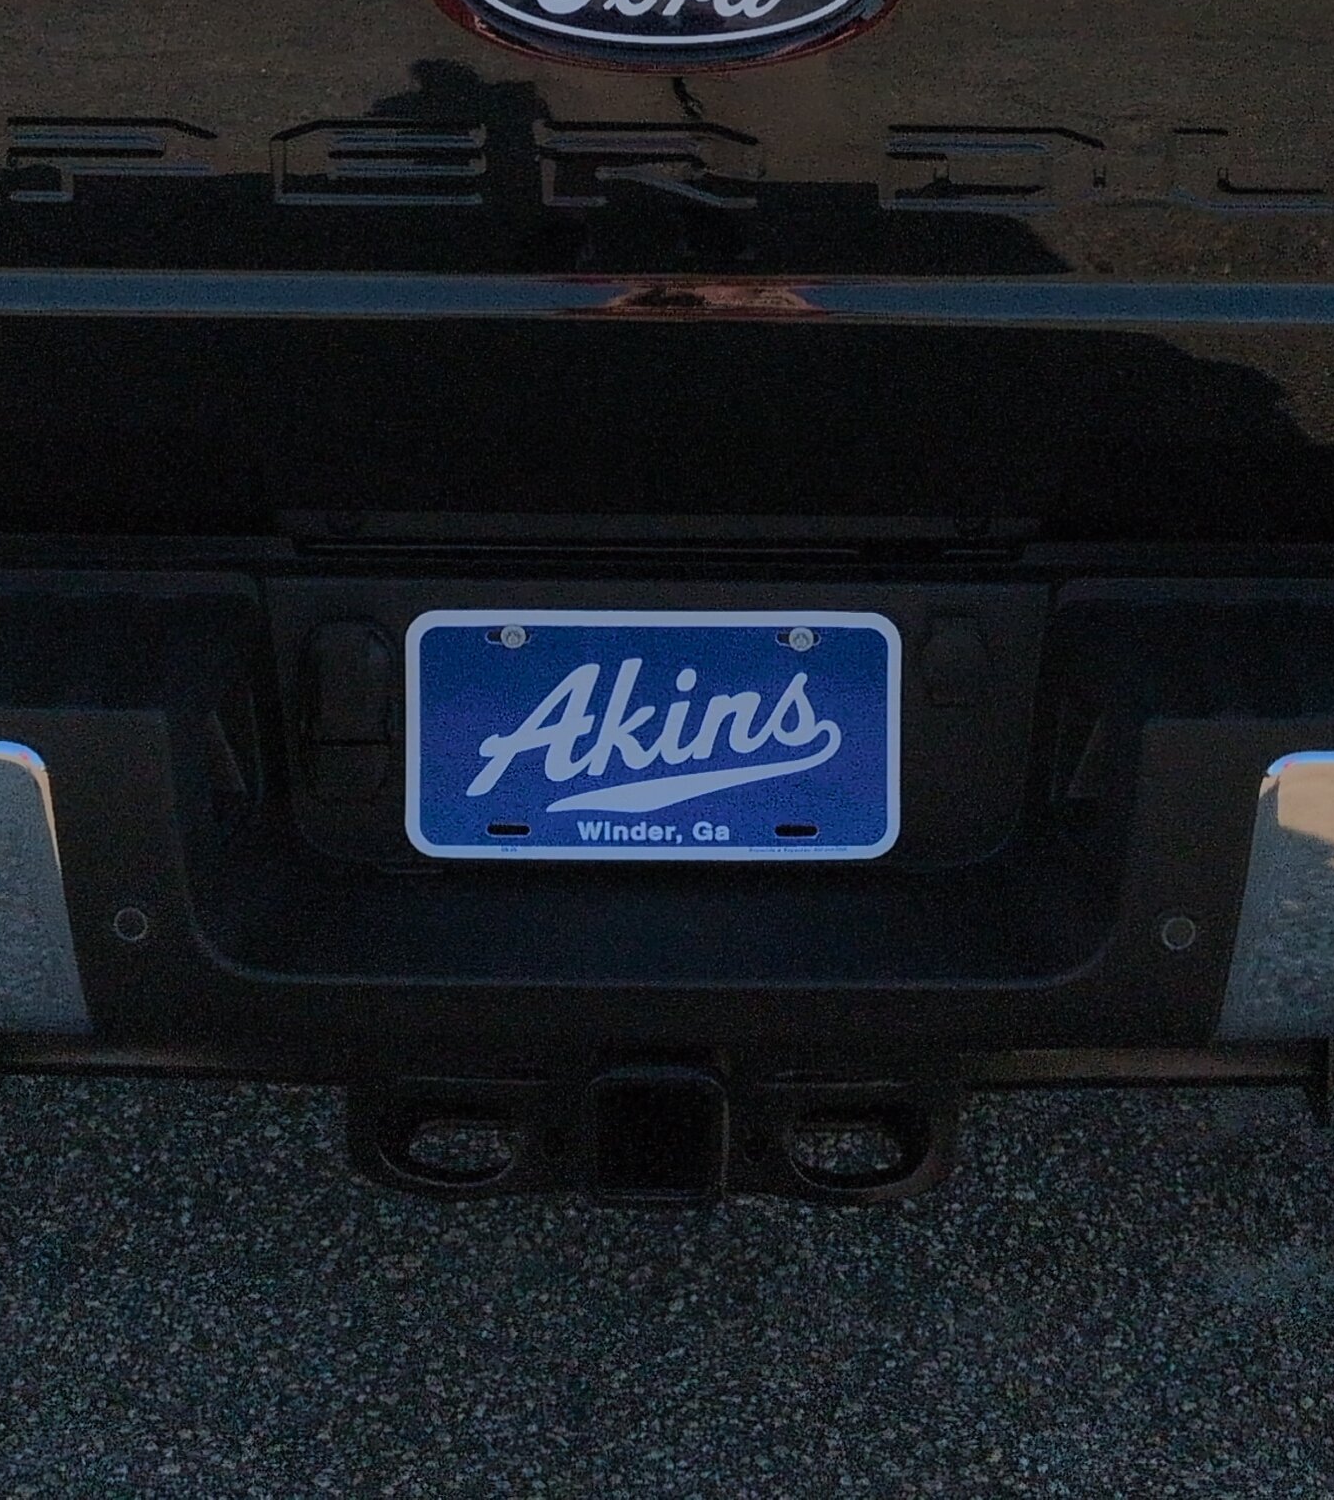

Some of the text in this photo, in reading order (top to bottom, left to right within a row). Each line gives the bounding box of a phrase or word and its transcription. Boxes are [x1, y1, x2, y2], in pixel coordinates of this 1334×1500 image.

[466, 658, 842, 813] Akins
[577, 821, 730, 844] Winder, Ga
